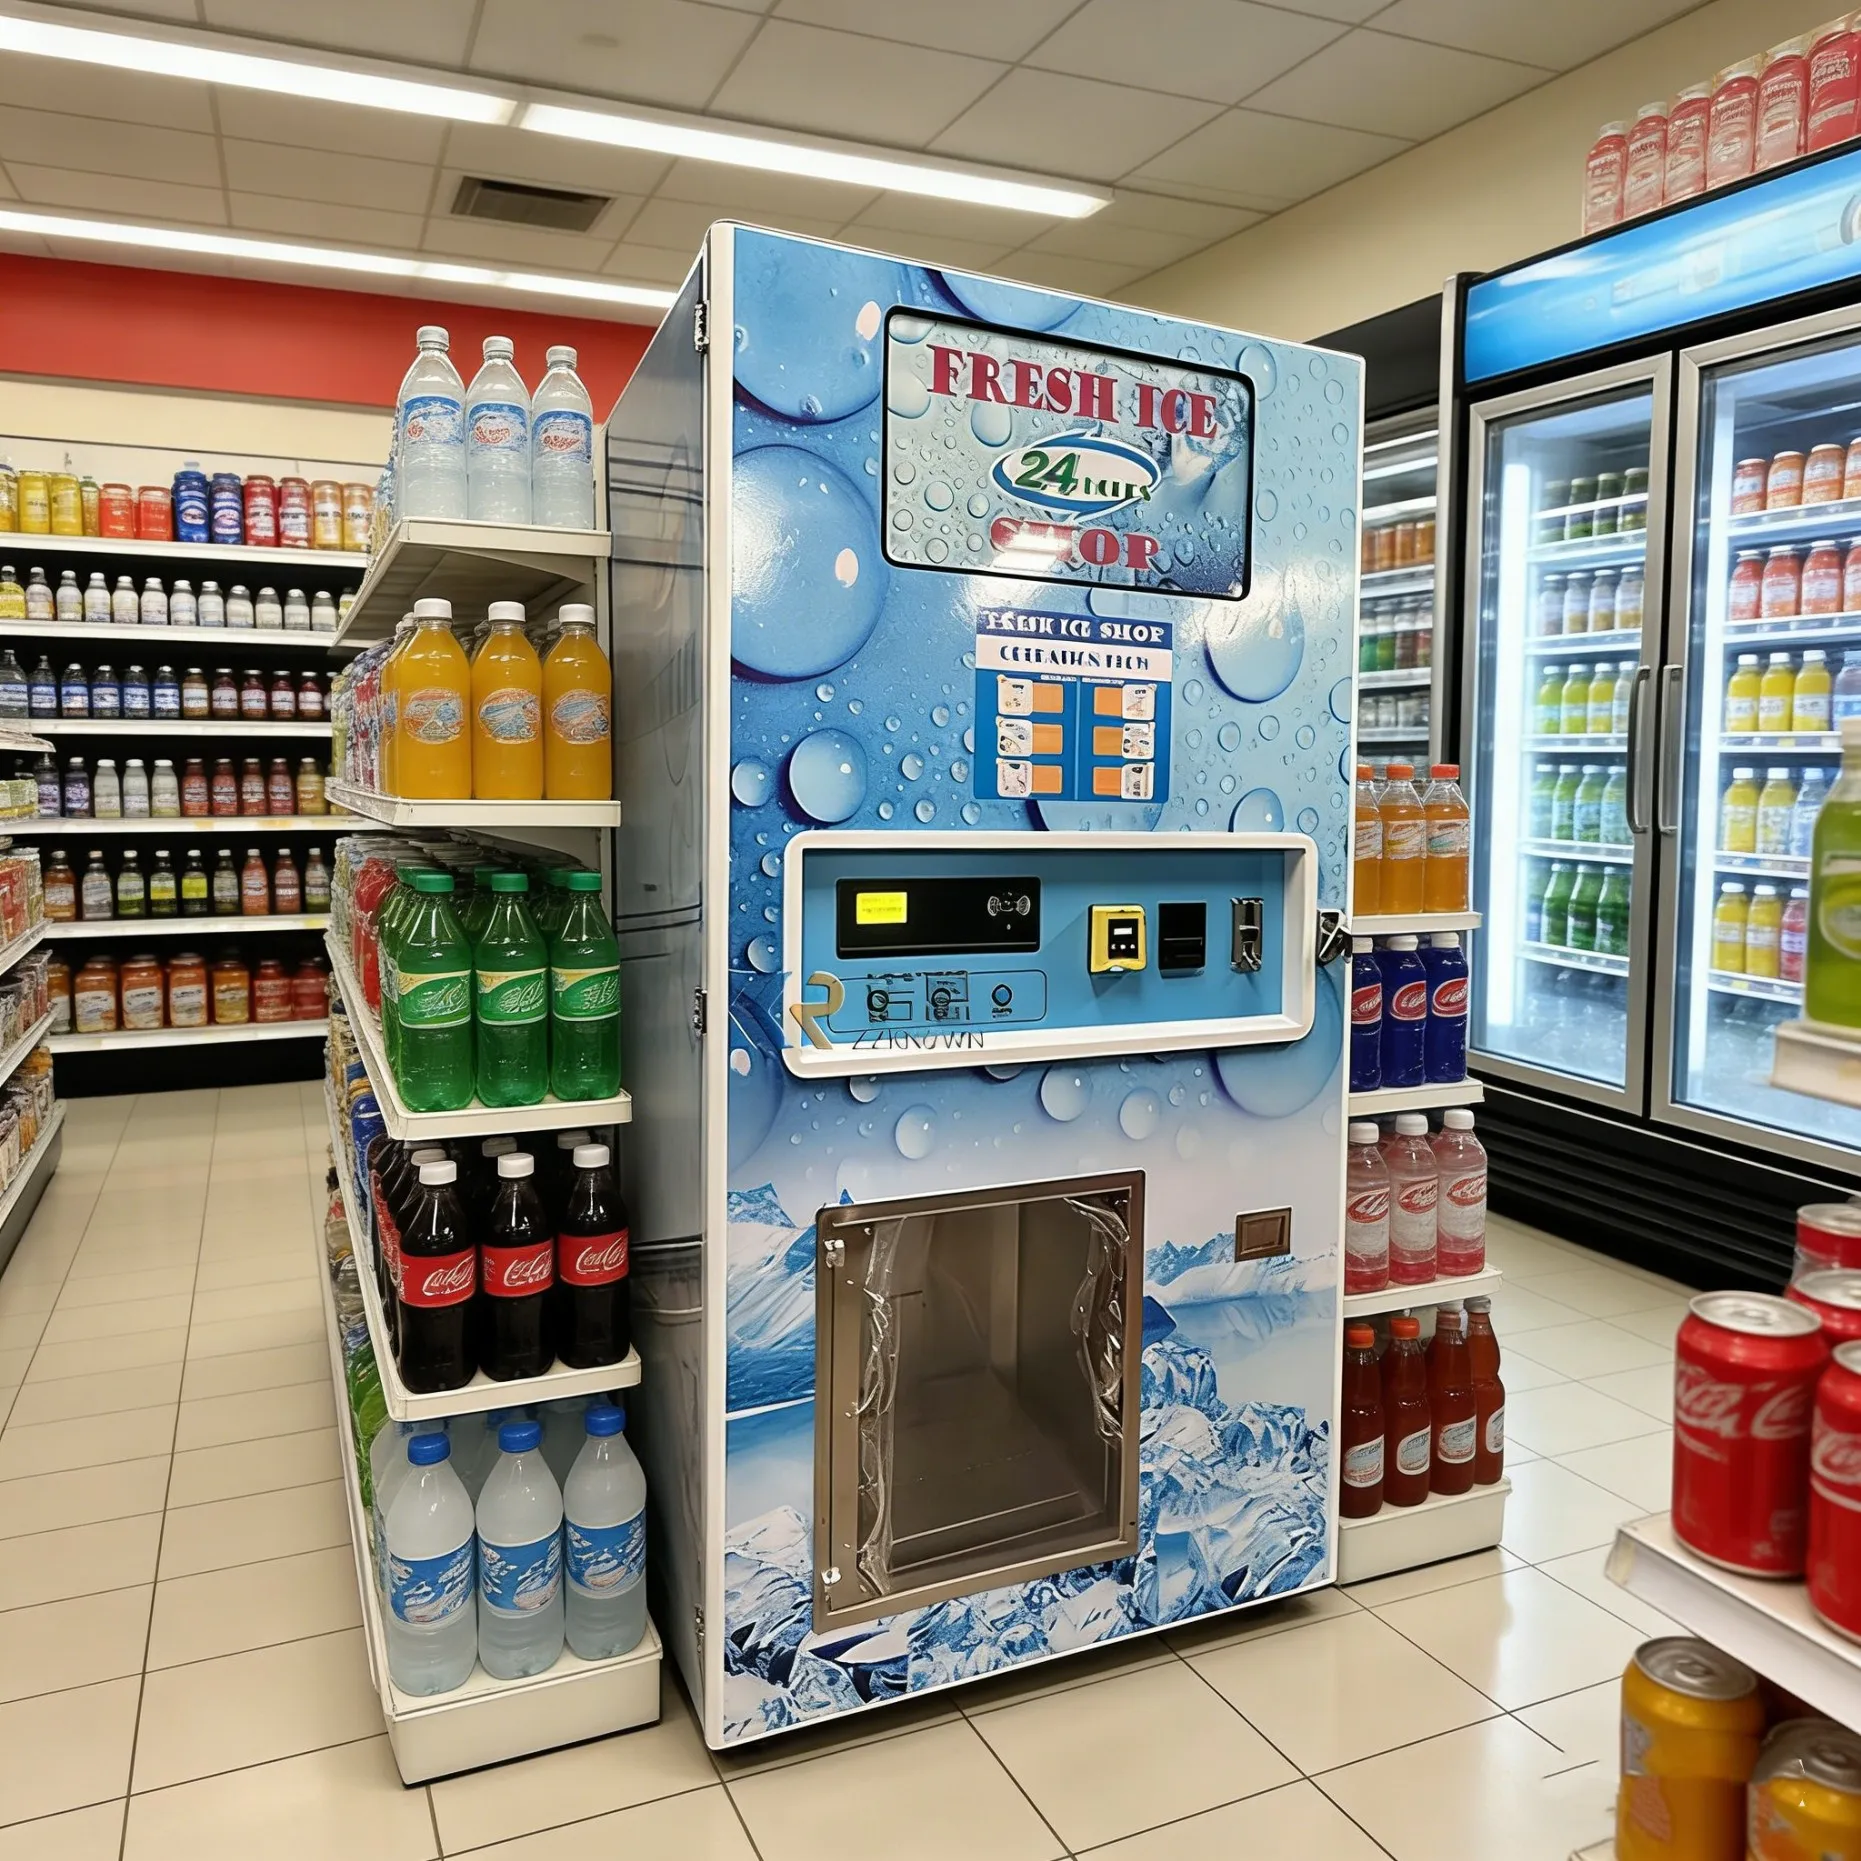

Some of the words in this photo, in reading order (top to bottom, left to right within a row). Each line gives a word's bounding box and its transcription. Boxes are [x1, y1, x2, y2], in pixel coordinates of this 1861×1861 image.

[926, 343, 1120, 424] FRESH
[1134, 382, 1219, 440] ICE
[1014, 449, 1081, 496] 24
